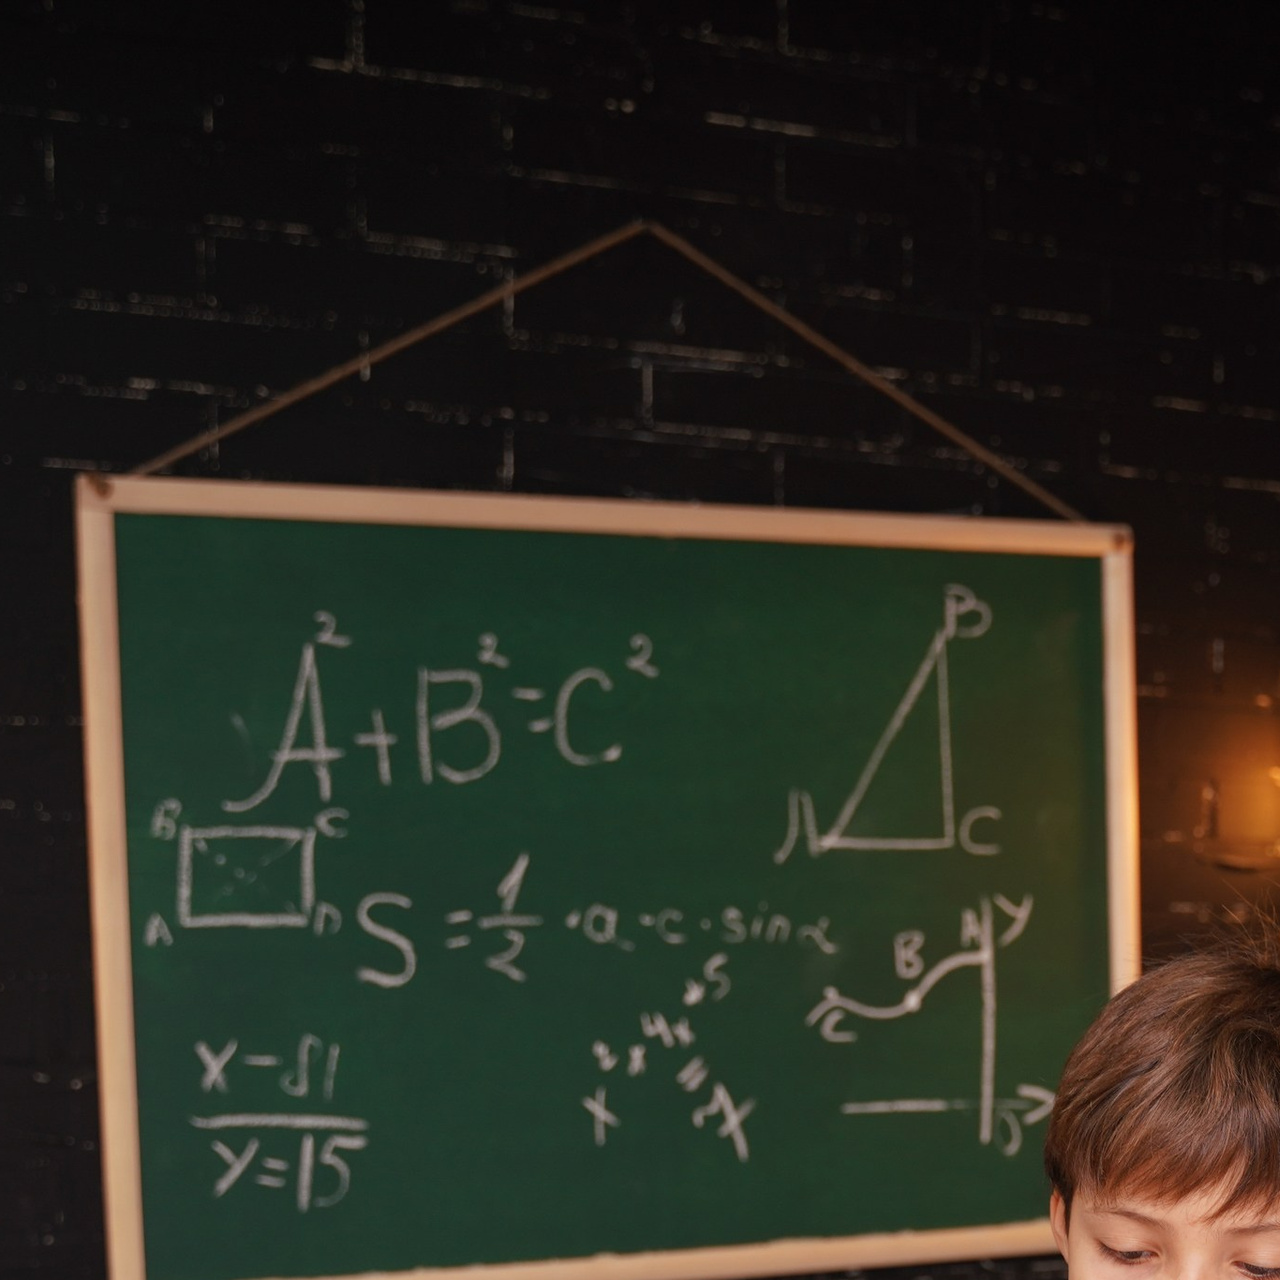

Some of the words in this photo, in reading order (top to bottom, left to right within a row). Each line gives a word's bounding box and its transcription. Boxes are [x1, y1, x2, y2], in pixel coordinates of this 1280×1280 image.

[945, 583, 994, 640] B
[958, 804, 1003, 856] C
[893, 930, 926, 979] B
